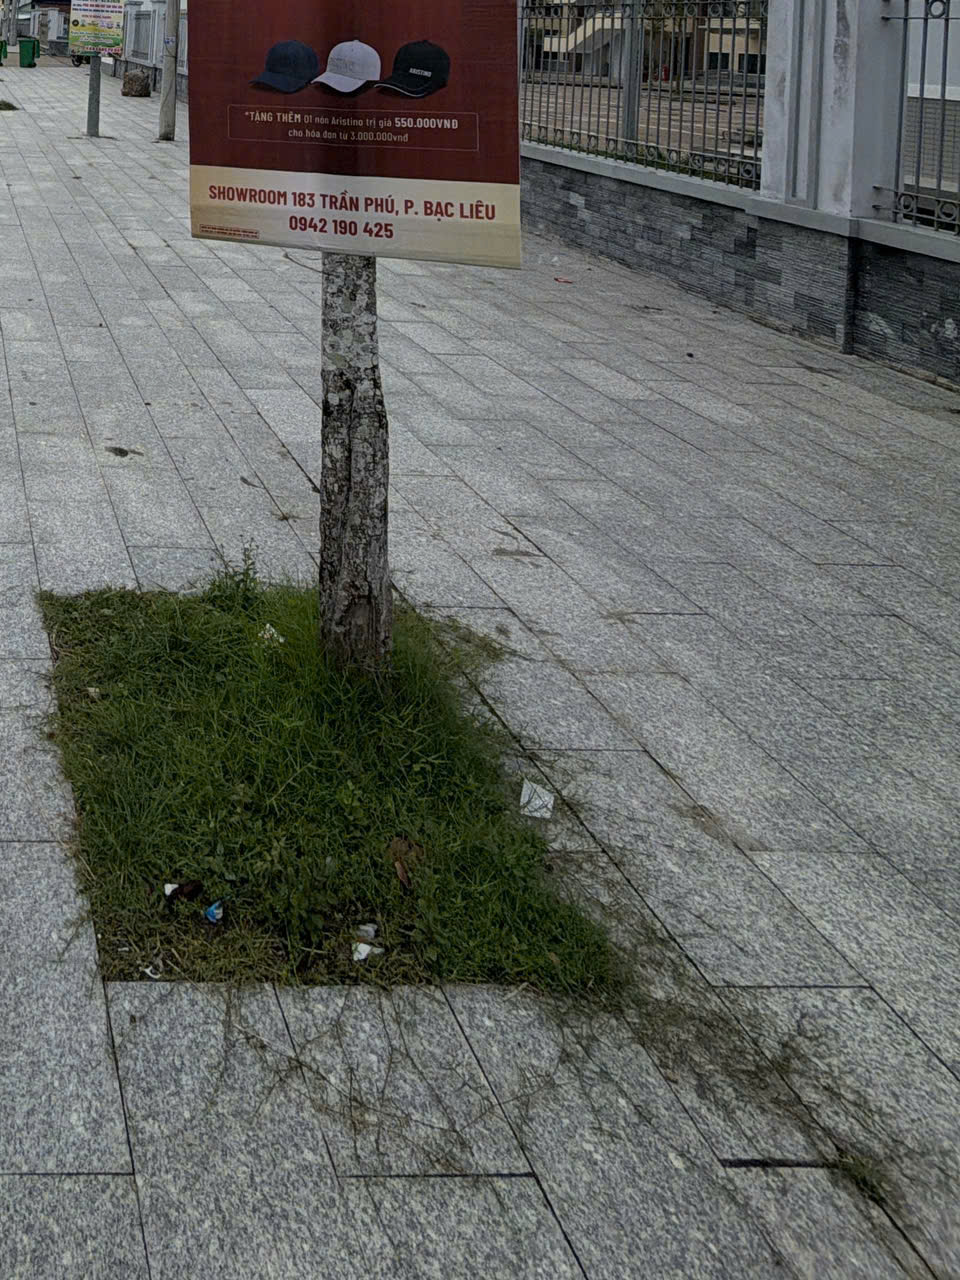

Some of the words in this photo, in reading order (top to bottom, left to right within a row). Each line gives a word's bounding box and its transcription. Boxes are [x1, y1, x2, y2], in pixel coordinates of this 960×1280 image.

[276, 111, 301, 124] THÊM
[304, 115, 313, 123] 01
[331, 115, 364, 127] Aristino
[394, 117, 459, 130] 550.000VNĐ
[288, 128, 303, 137] cho
[208, 184, 288, 207] SHOWROOM
[291, 191, 316, 209] 183
[319, 189, 360, 212] TRẦN
[363, 193, 400, 216] PHÚ,
[404, 199, 419, 216] P.
[424, 201, 455, 222] BẠC
[459, 199, 497, 221] LIÊU
[289, 215, 328, 234] 0942
[332, 218, 358, 237] 190
[362, 220, 394, 239] 425
